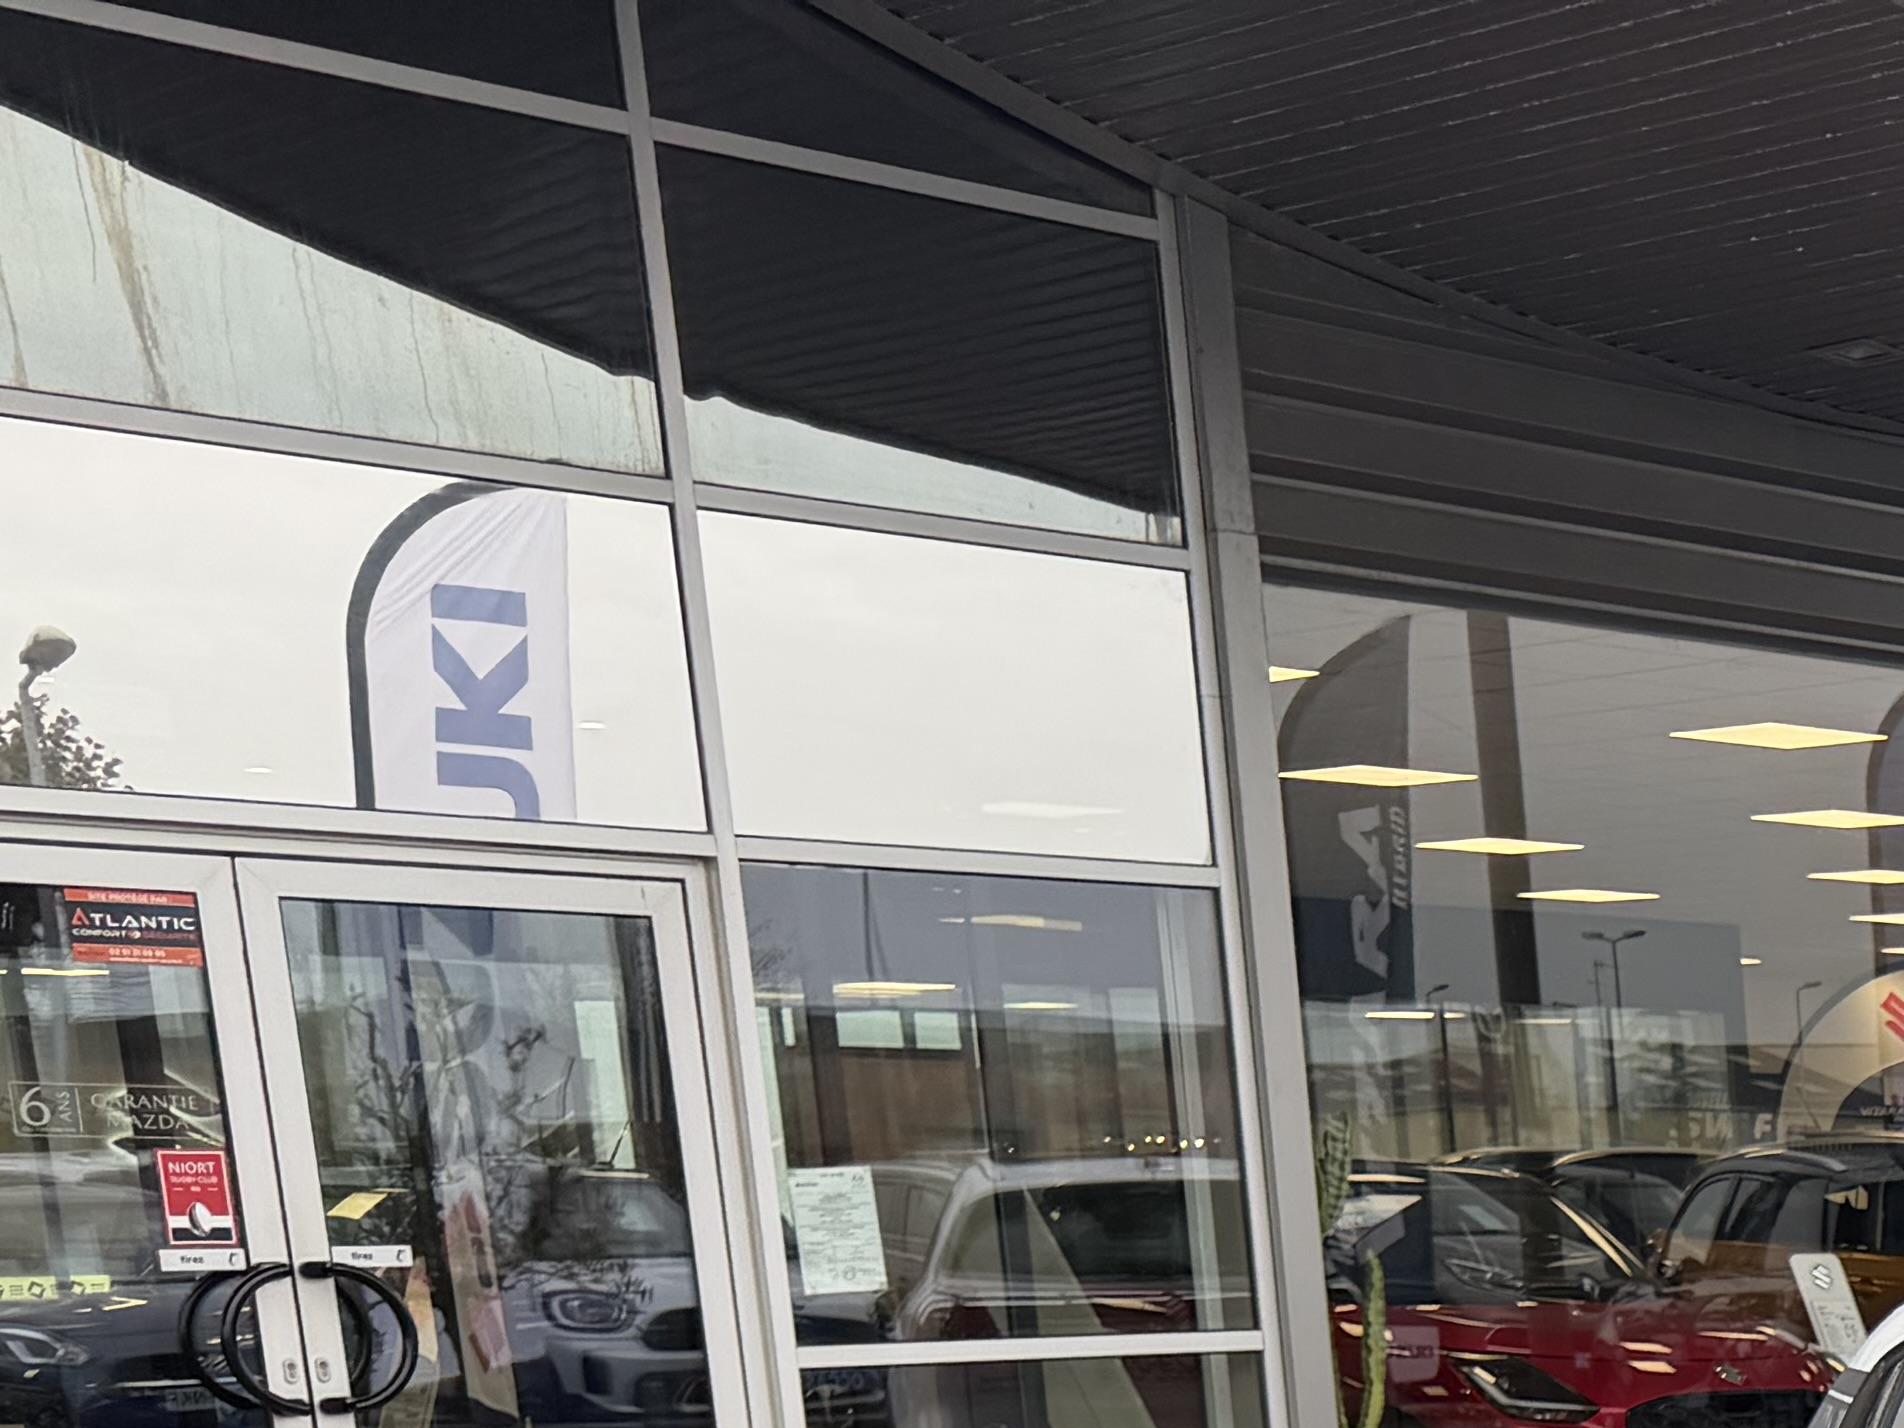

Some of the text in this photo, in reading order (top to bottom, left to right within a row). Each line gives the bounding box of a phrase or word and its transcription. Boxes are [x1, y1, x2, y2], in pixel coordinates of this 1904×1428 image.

[71, 907, 196, 930] ATLANTIC
[19, 1086, 52, 1127] 6
[90, 1091, 200, 1111] GARANTIE
[107, 1113, 189, 1130] MAZDA
[168, 1162, 216, 1174] NIORT
